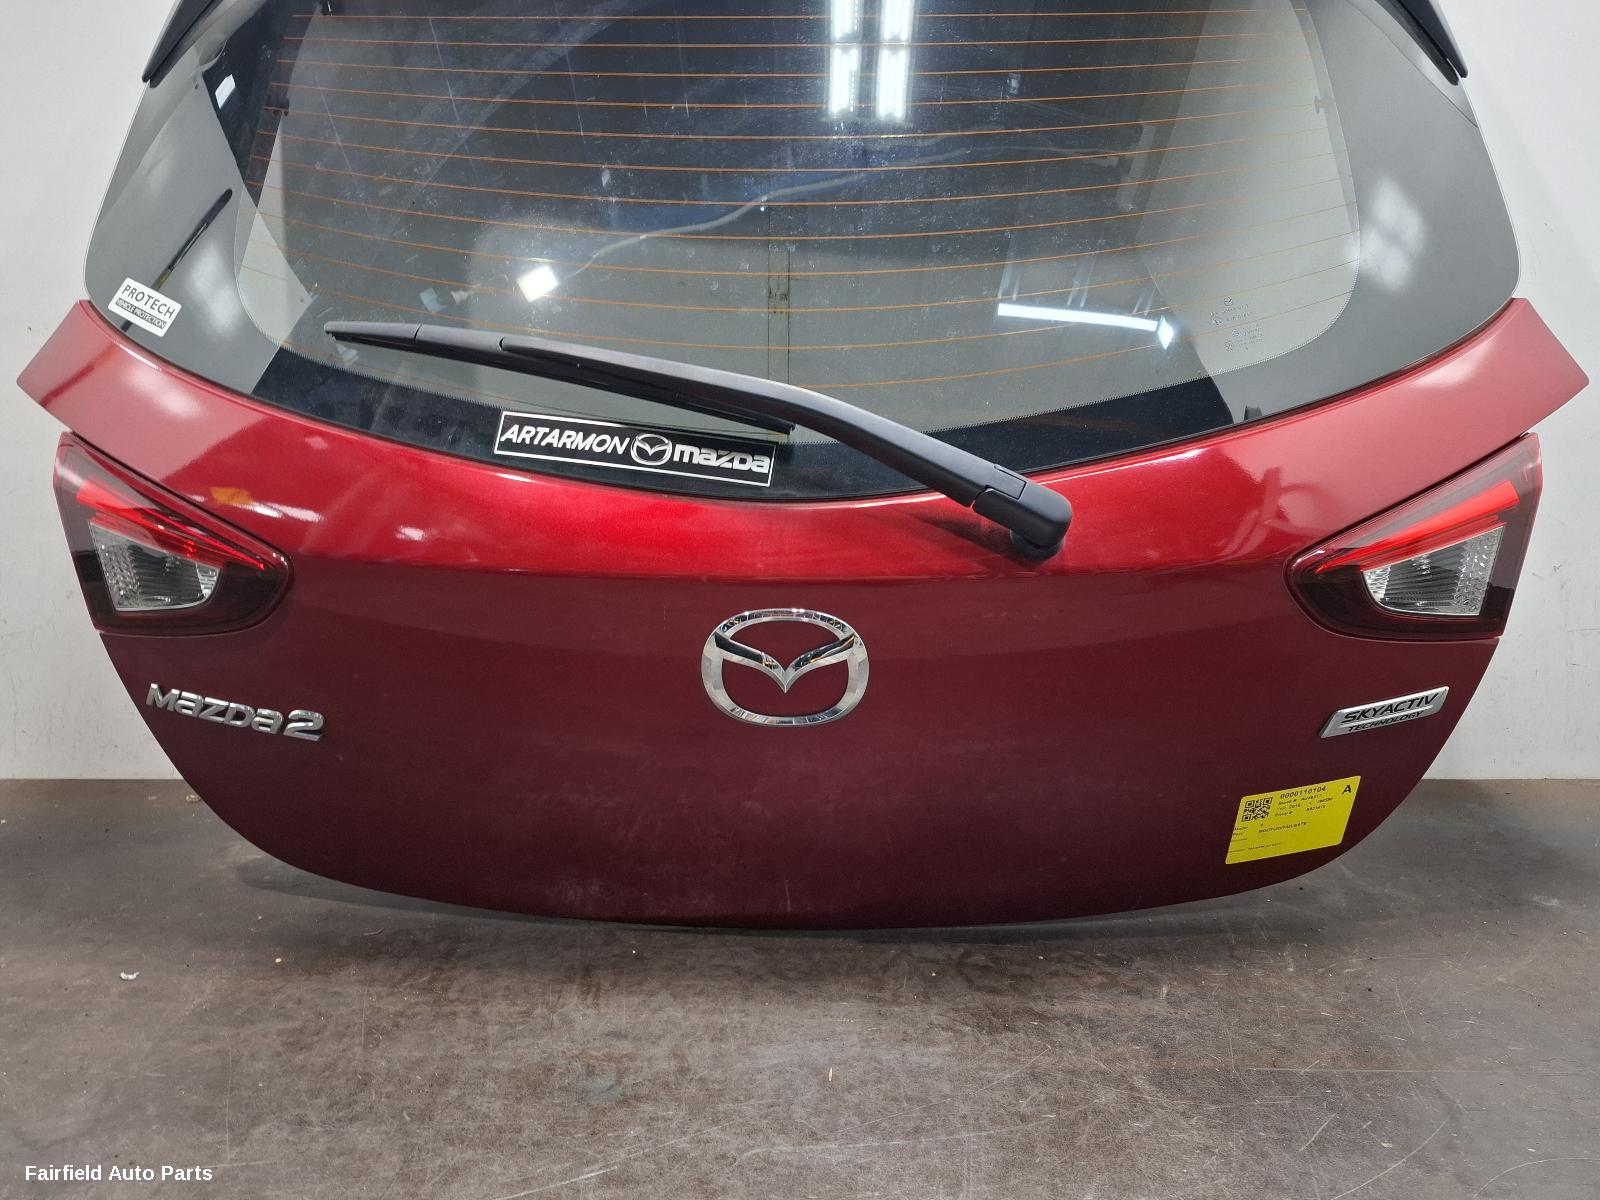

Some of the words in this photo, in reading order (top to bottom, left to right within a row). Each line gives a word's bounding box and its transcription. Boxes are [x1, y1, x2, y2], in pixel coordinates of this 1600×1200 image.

[122, 284, 176, 319] PROTECH
[500, 424, 630, 455] ARTARMON
[1341, 693, 1439, 723] SKYACTIV
[1348, 710, 1425, 732] TECHNOLOGY
[1280, 786, 1327, 799] 0000110104
[1341, 784, 1352, 794] A
